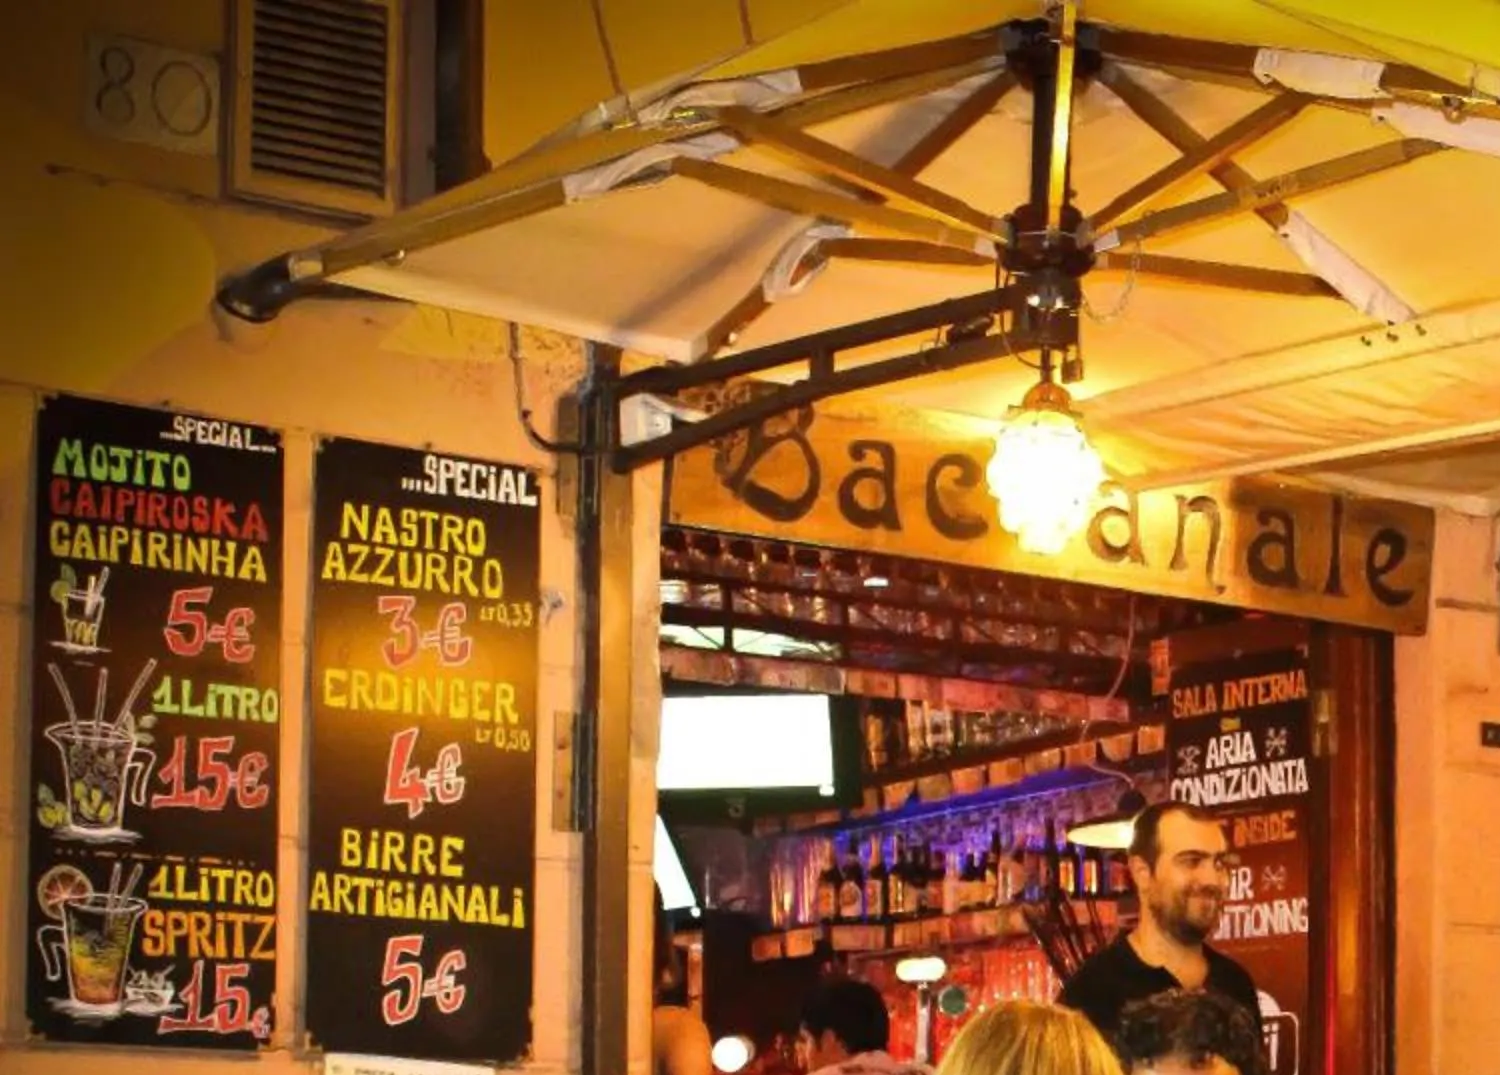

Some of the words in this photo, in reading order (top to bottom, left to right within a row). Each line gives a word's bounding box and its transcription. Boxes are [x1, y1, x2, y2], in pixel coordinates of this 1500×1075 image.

[52, 438, 192, 491] MOJITO
[50, 475, 269, 543] CAIPIROSKA
[714, 394, 1414, 607] Bacanale
[50, 520, 267, 583] CAIPIRINHA
[340, 502, 487, 557] NASTRO
[321, 541, 503, 598] AZZURRO
[323, 668, 519, 725] ERDINGER
[1173, 683, 1217, 718] SALA
[1222, 669, 1307, 711] INTERNA
[1205, 730, 1257, 770] ARIA
[1170, 758, 1309, 806] CONDIZIONATA
[340, 827, 465, 878] BIRRE
[309, 872, 525, 929] ARTIGIANALI
[1229, 866, 1254, 900] IR
[142, 909, 276, 958] SPRITZ
